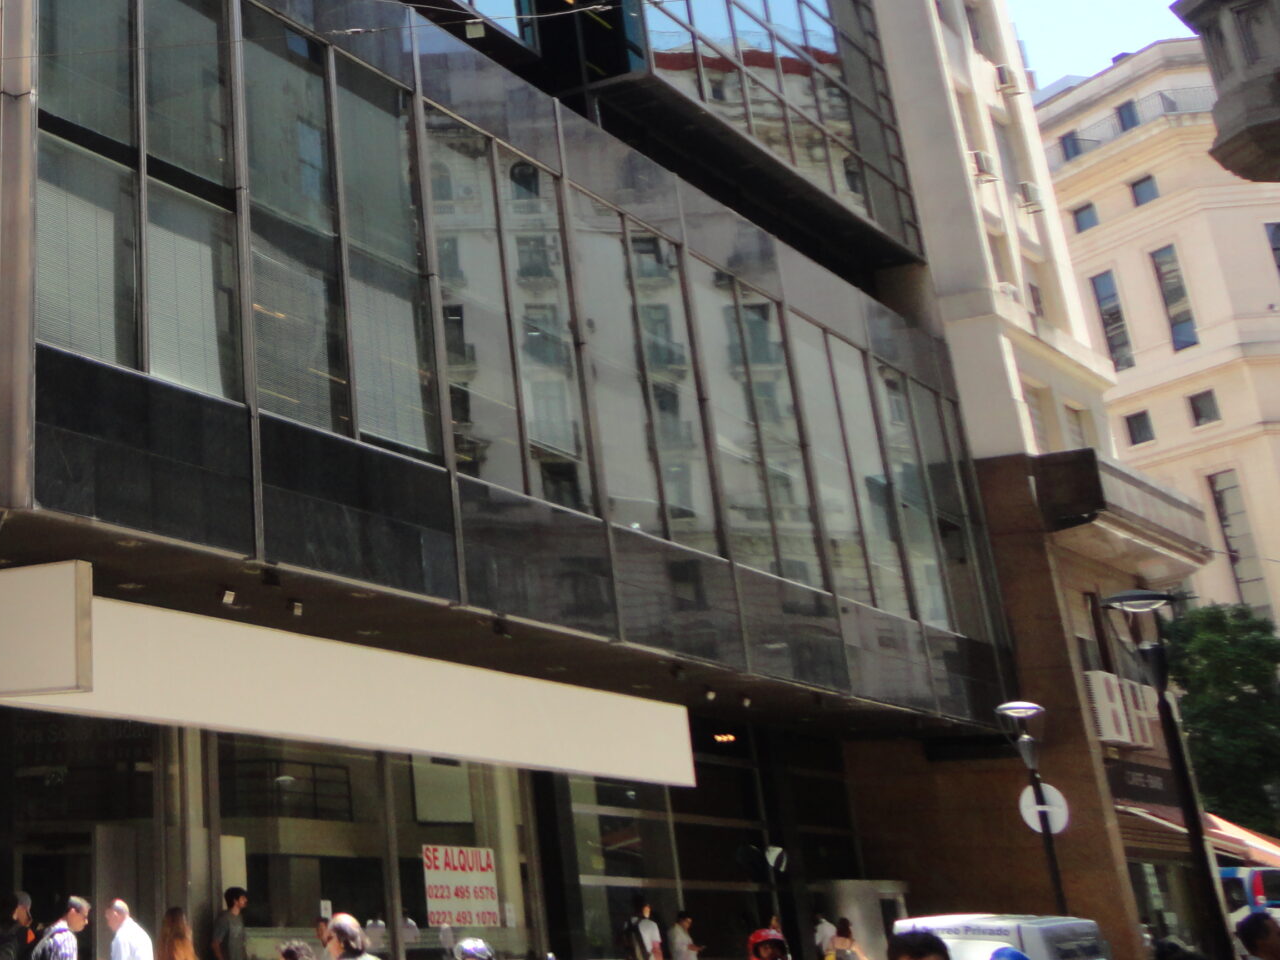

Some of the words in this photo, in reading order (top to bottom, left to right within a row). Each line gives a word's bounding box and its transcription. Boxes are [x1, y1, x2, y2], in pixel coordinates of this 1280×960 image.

[424, 847, 439, 870] SE
[443, 847, 494, 872] ALQUILA
[428, 885, 450, 898] 0223
[963, 926, 1010, 937] Privado
